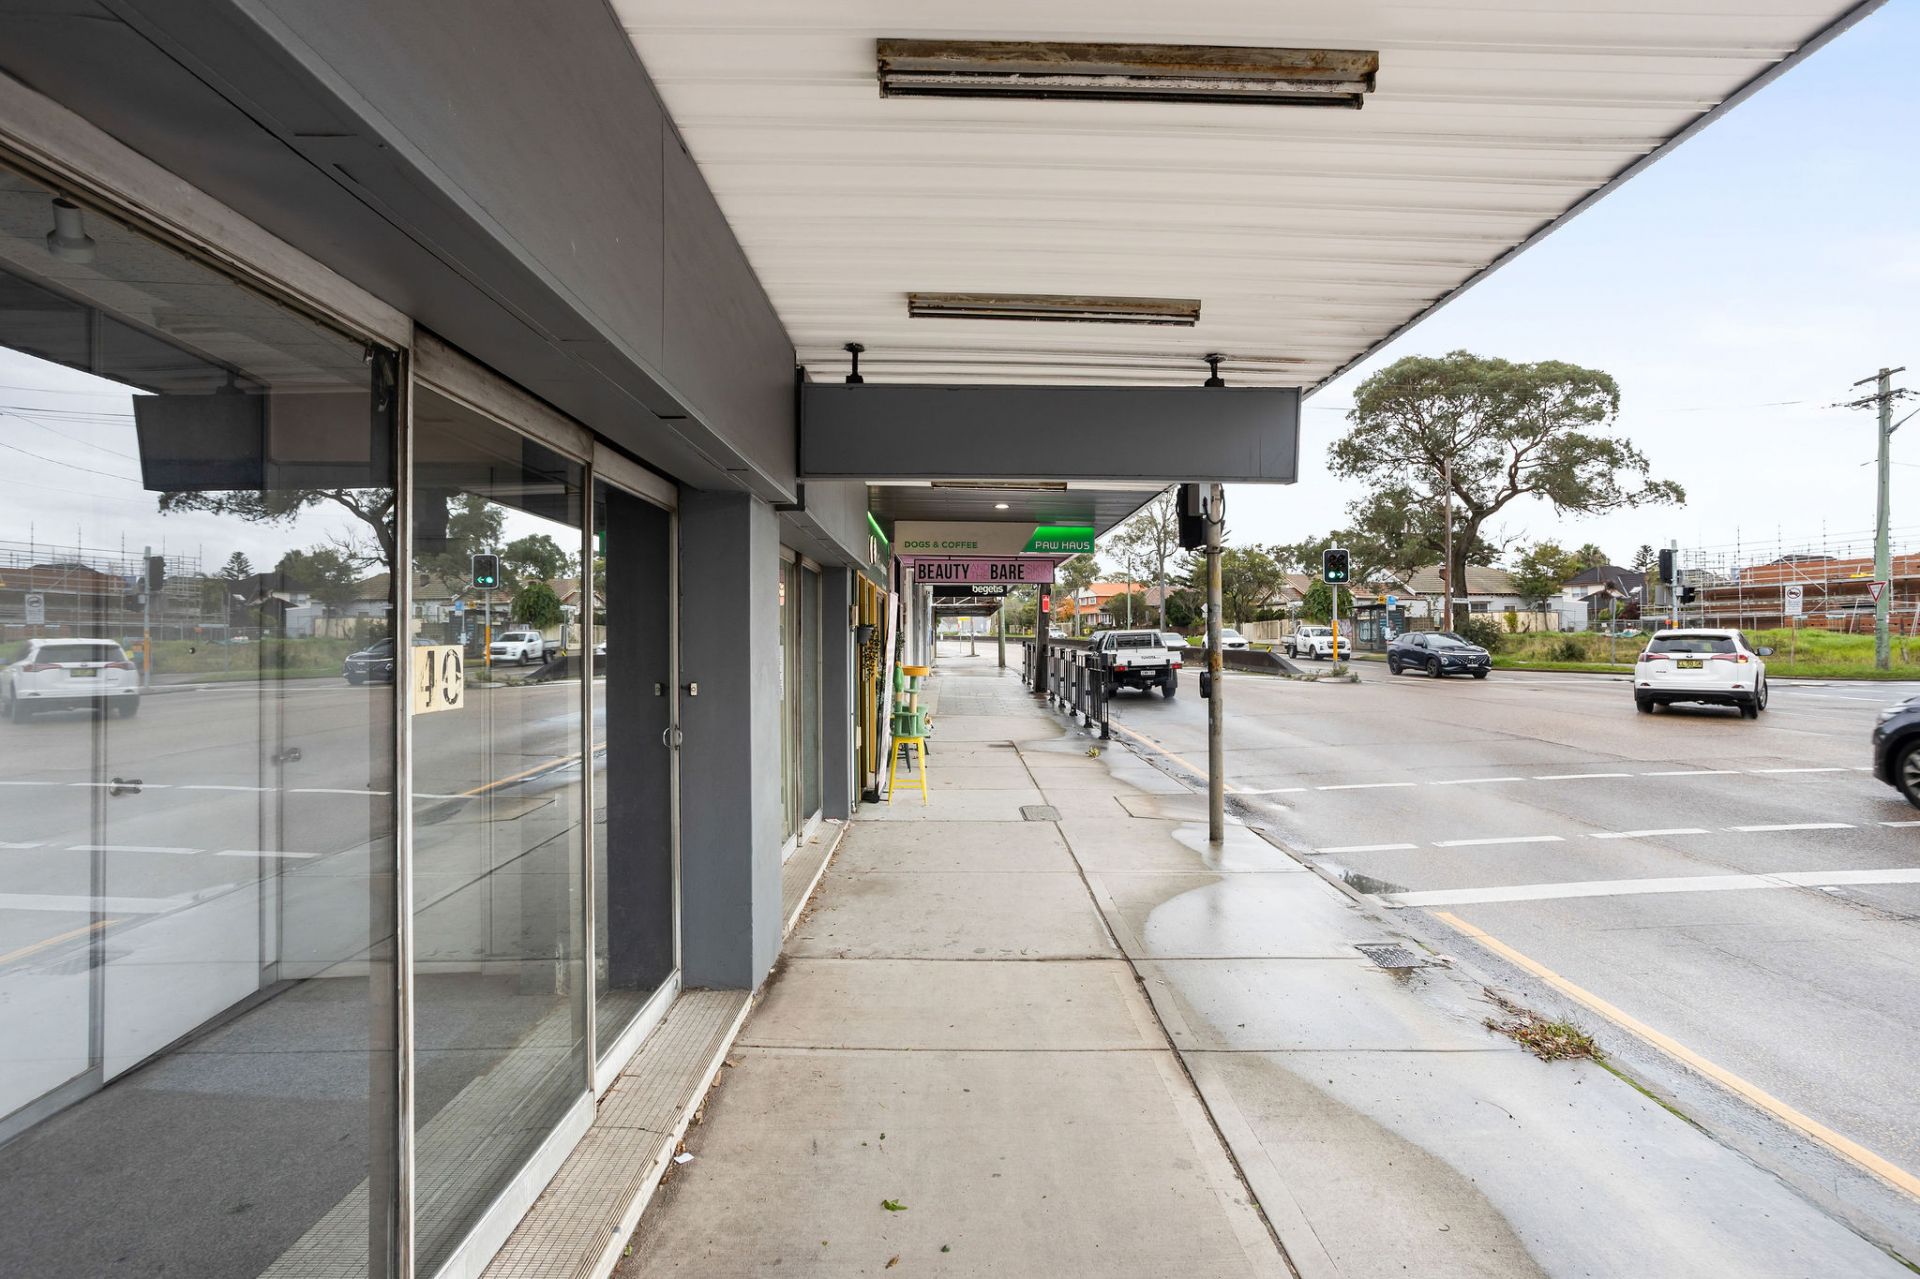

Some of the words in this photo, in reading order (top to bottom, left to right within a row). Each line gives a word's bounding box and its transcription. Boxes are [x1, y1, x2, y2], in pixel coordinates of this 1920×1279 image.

[904, 540, 931, 549] DOGS
[933, 541, 940, 549] &
[941, 541, 978, 549] COFFEE
[1035, 540, 1060, 550] PAW
[1061, 540, 1090, 550] HAUS
[918, 563, 970, 580] BEAUTY
[990, 563, 1025, 580] BARE
